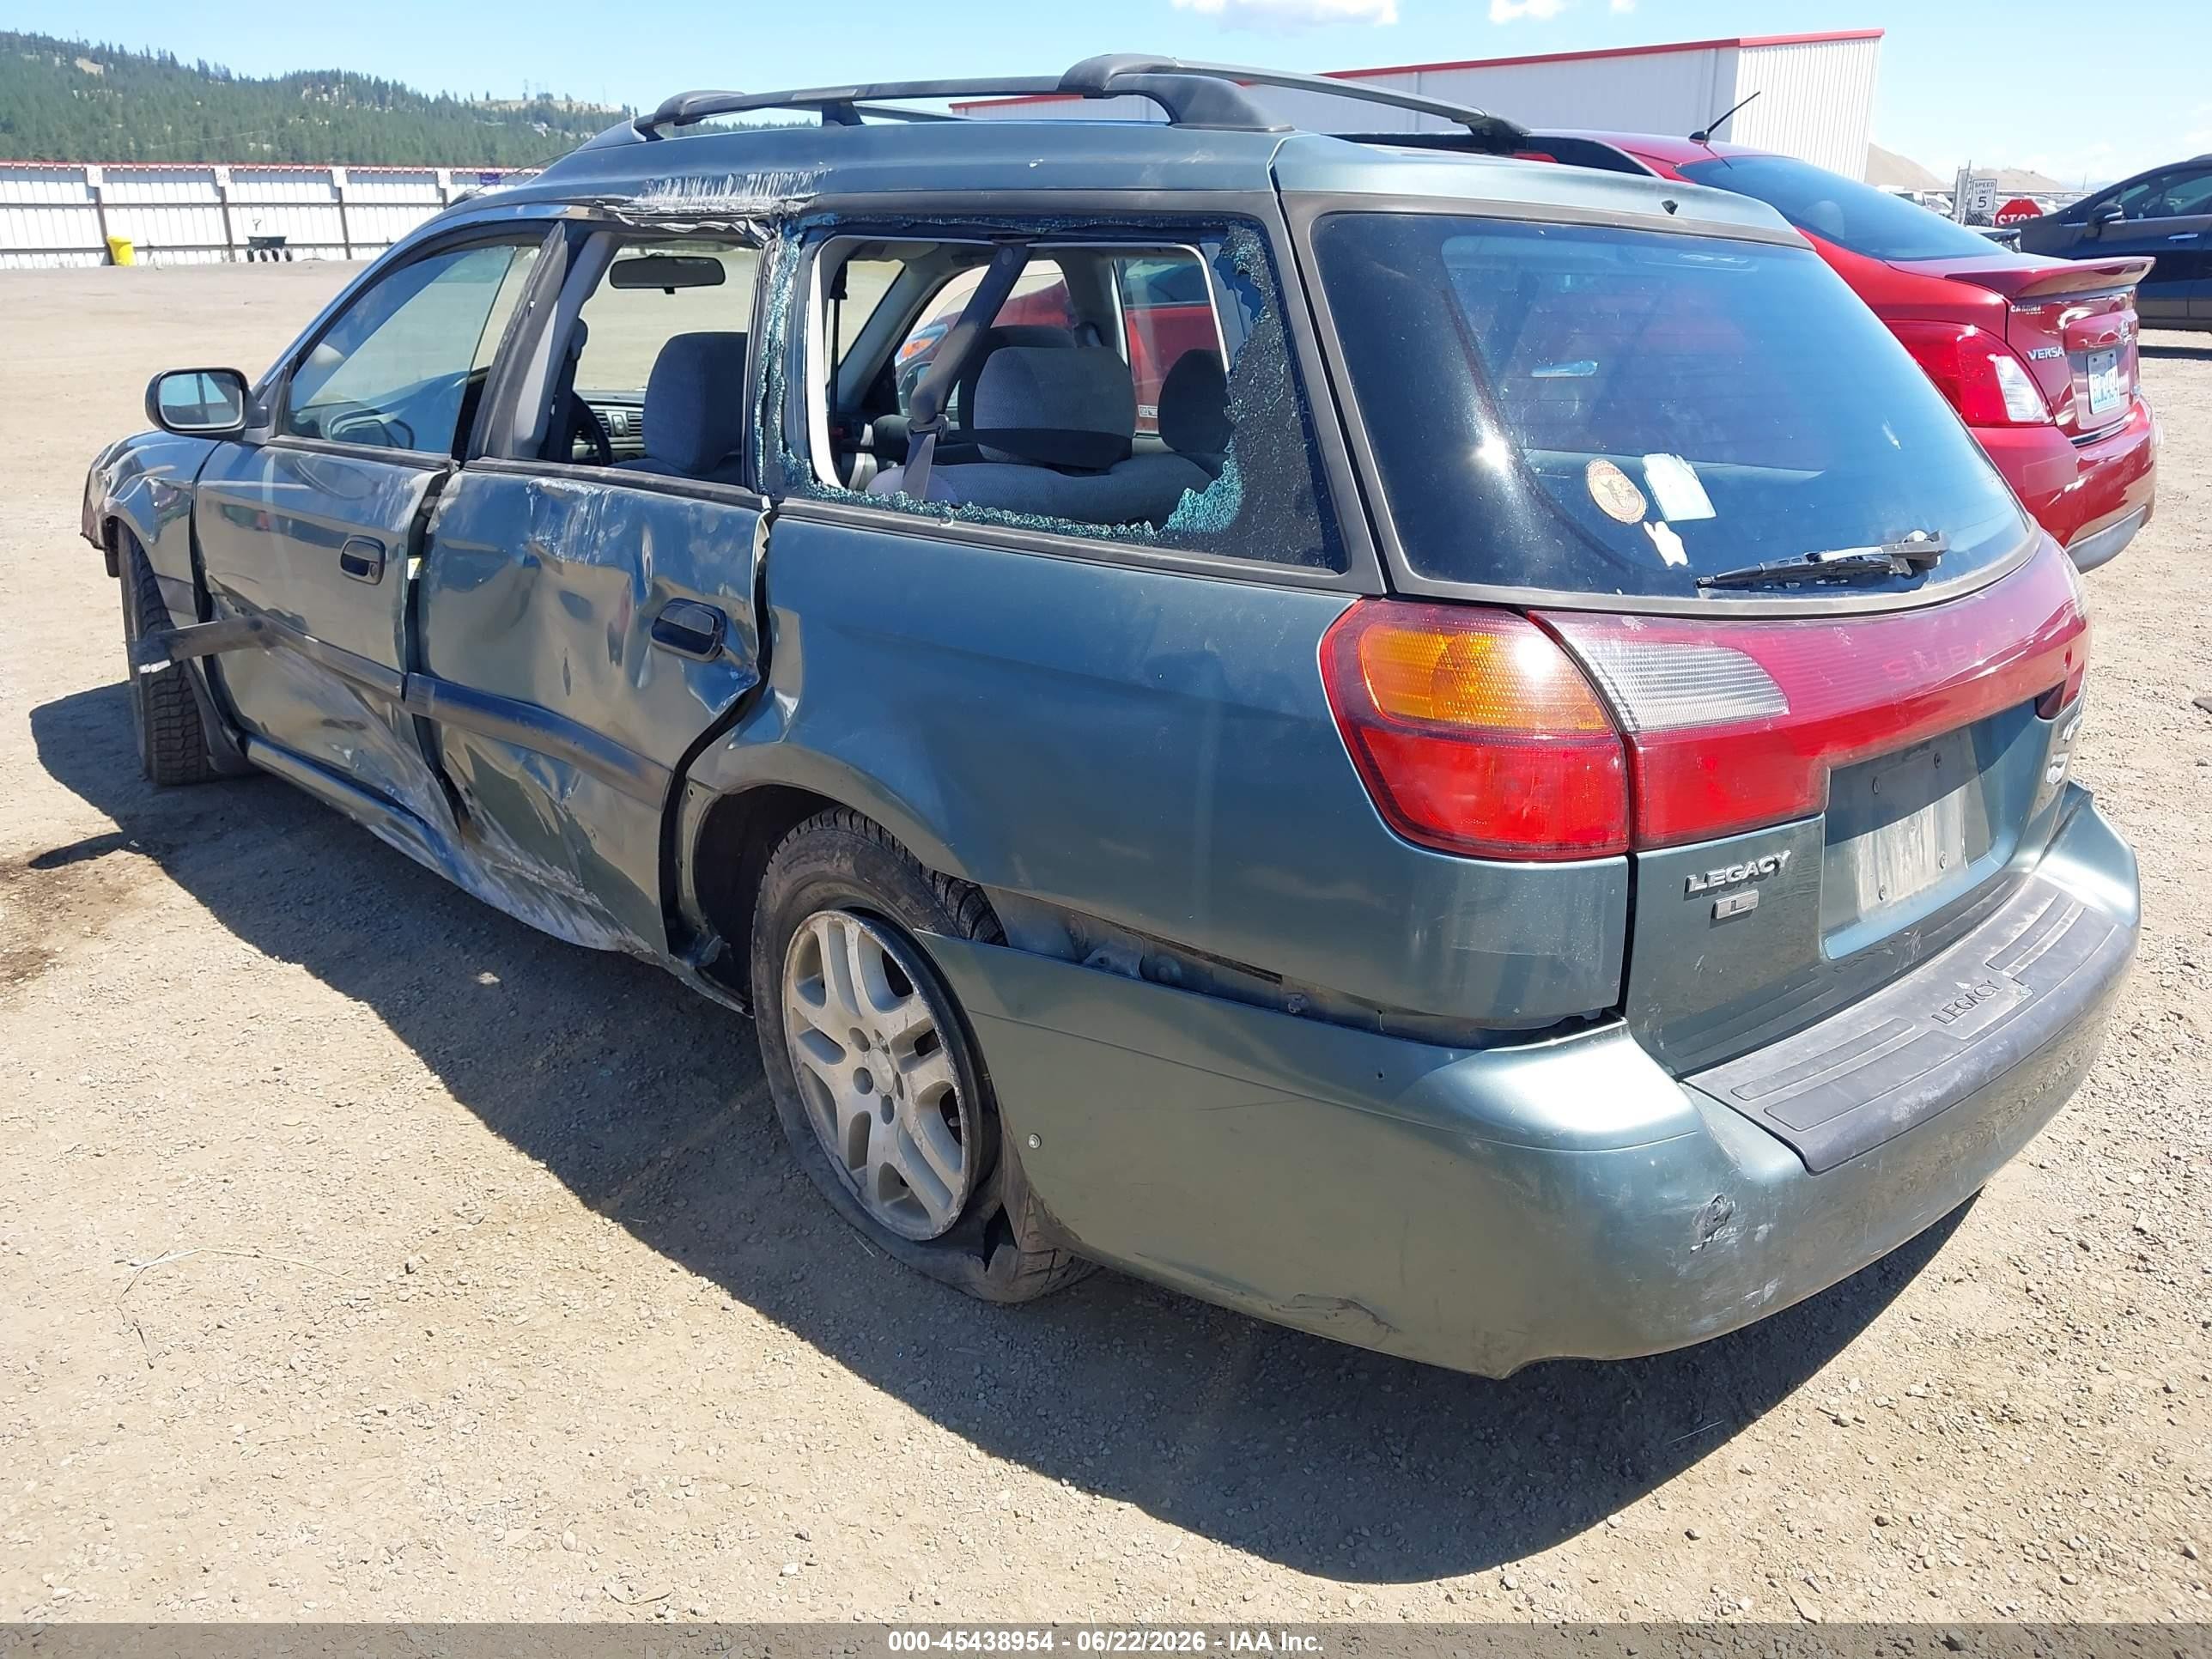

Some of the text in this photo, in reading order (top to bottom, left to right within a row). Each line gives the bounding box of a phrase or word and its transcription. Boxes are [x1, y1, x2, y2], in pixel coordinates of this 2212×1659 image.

[1977, 196, 1987, 208] 5
[2027, 345, 2065, 361] VERSA
[1685, 849, 1792, 893] LEGACY
[1931, 980, 2002, 1025] LEGACY
